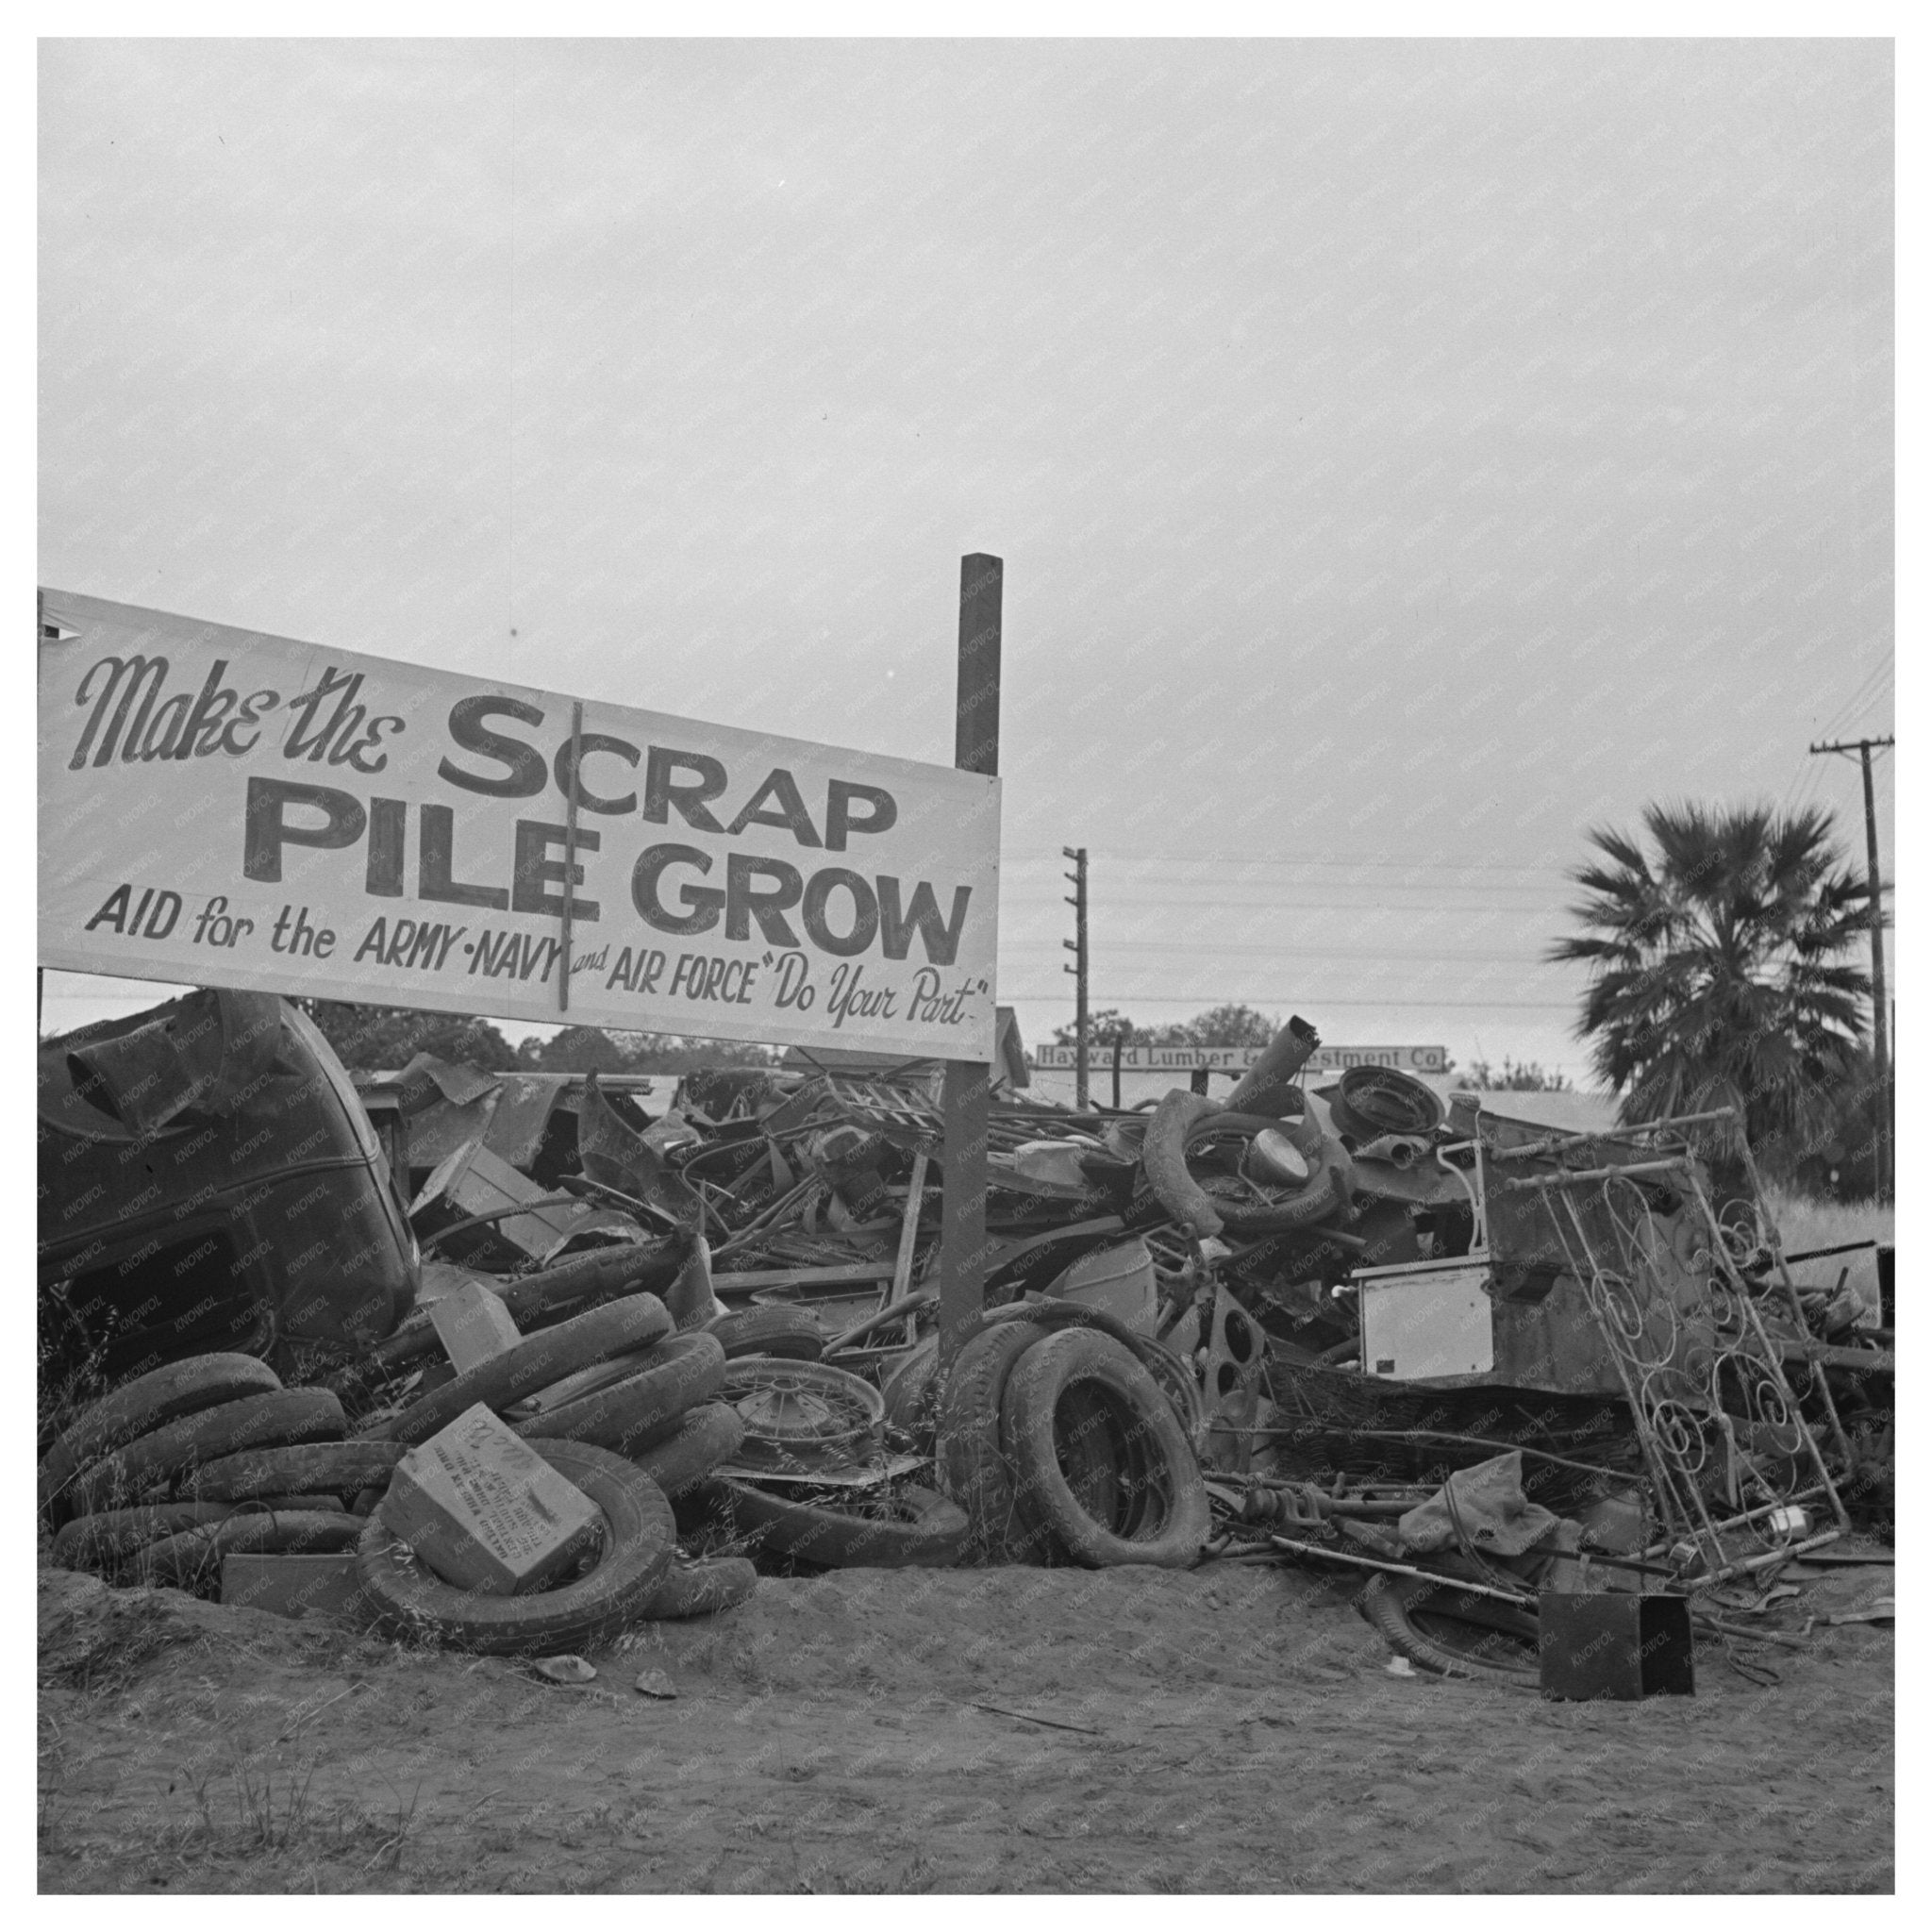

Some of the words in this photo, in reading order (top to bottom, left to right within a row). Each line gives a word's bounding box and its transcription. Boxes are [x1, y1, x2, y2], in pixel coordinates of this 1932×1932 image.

[68, 655, 280, 771] Make
[282, 666, 406, 774] the
[437, 695, 898, 852] SCRAP
[243, 775, 601, 923] PILE
[631, 842, 973, 967] GROW
[84, 883, 182, 940] AID
[192, 895, 254, 948] for
[271, 905, 337, 958] the
[569, 943, 610, 975] and
[605, 946, 666, 994] AIR
[669, 953, 759, 1005] FORCE
[827, 962, 898, 1028] Your
[1148, 1046, 1235, 1066] Lumber
